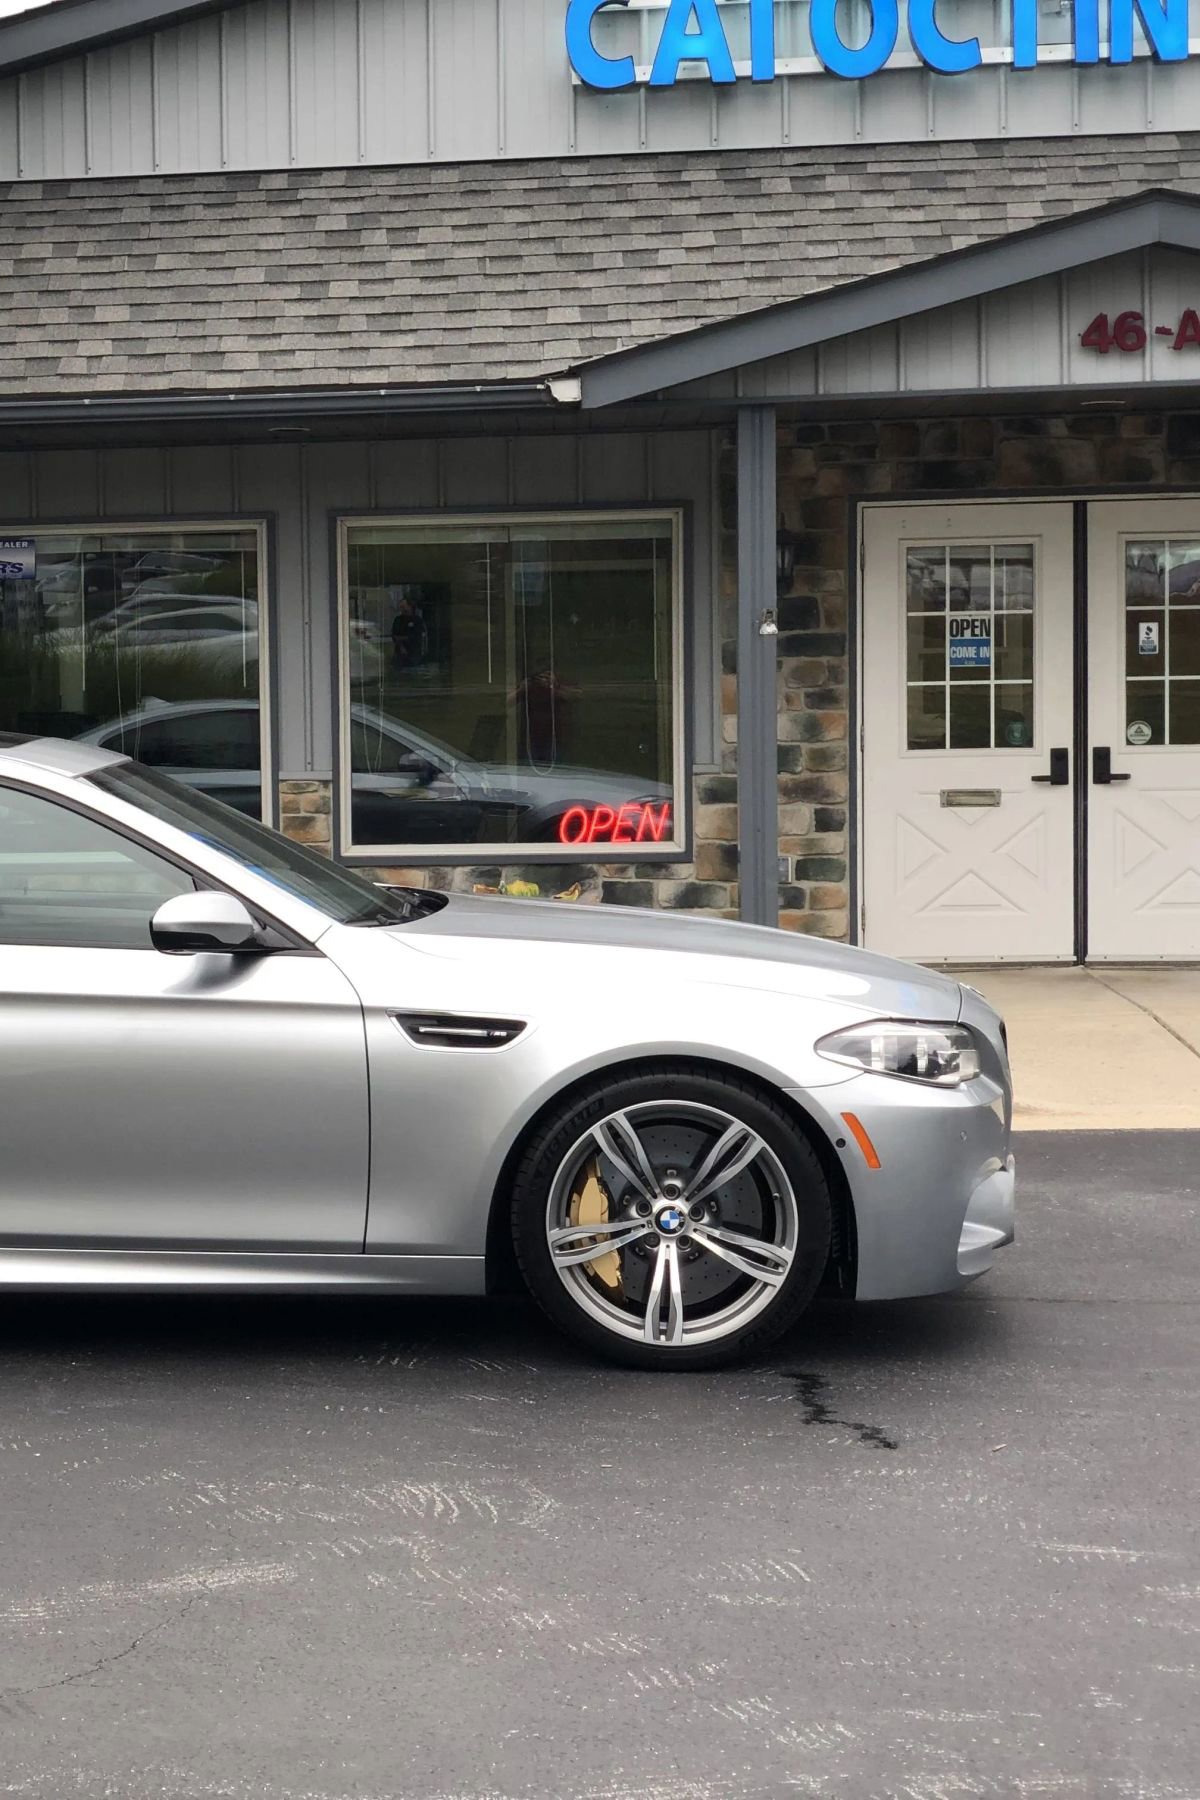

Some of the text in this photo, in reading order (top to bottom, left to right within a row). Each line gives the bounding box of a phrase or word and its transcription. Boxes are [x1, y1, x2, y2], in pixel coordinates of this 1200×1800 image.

[950, 618, 991, 637] OPEN
[950, 646, 990, 658] COME IN
[558, 802, 670, 844] OPEN
